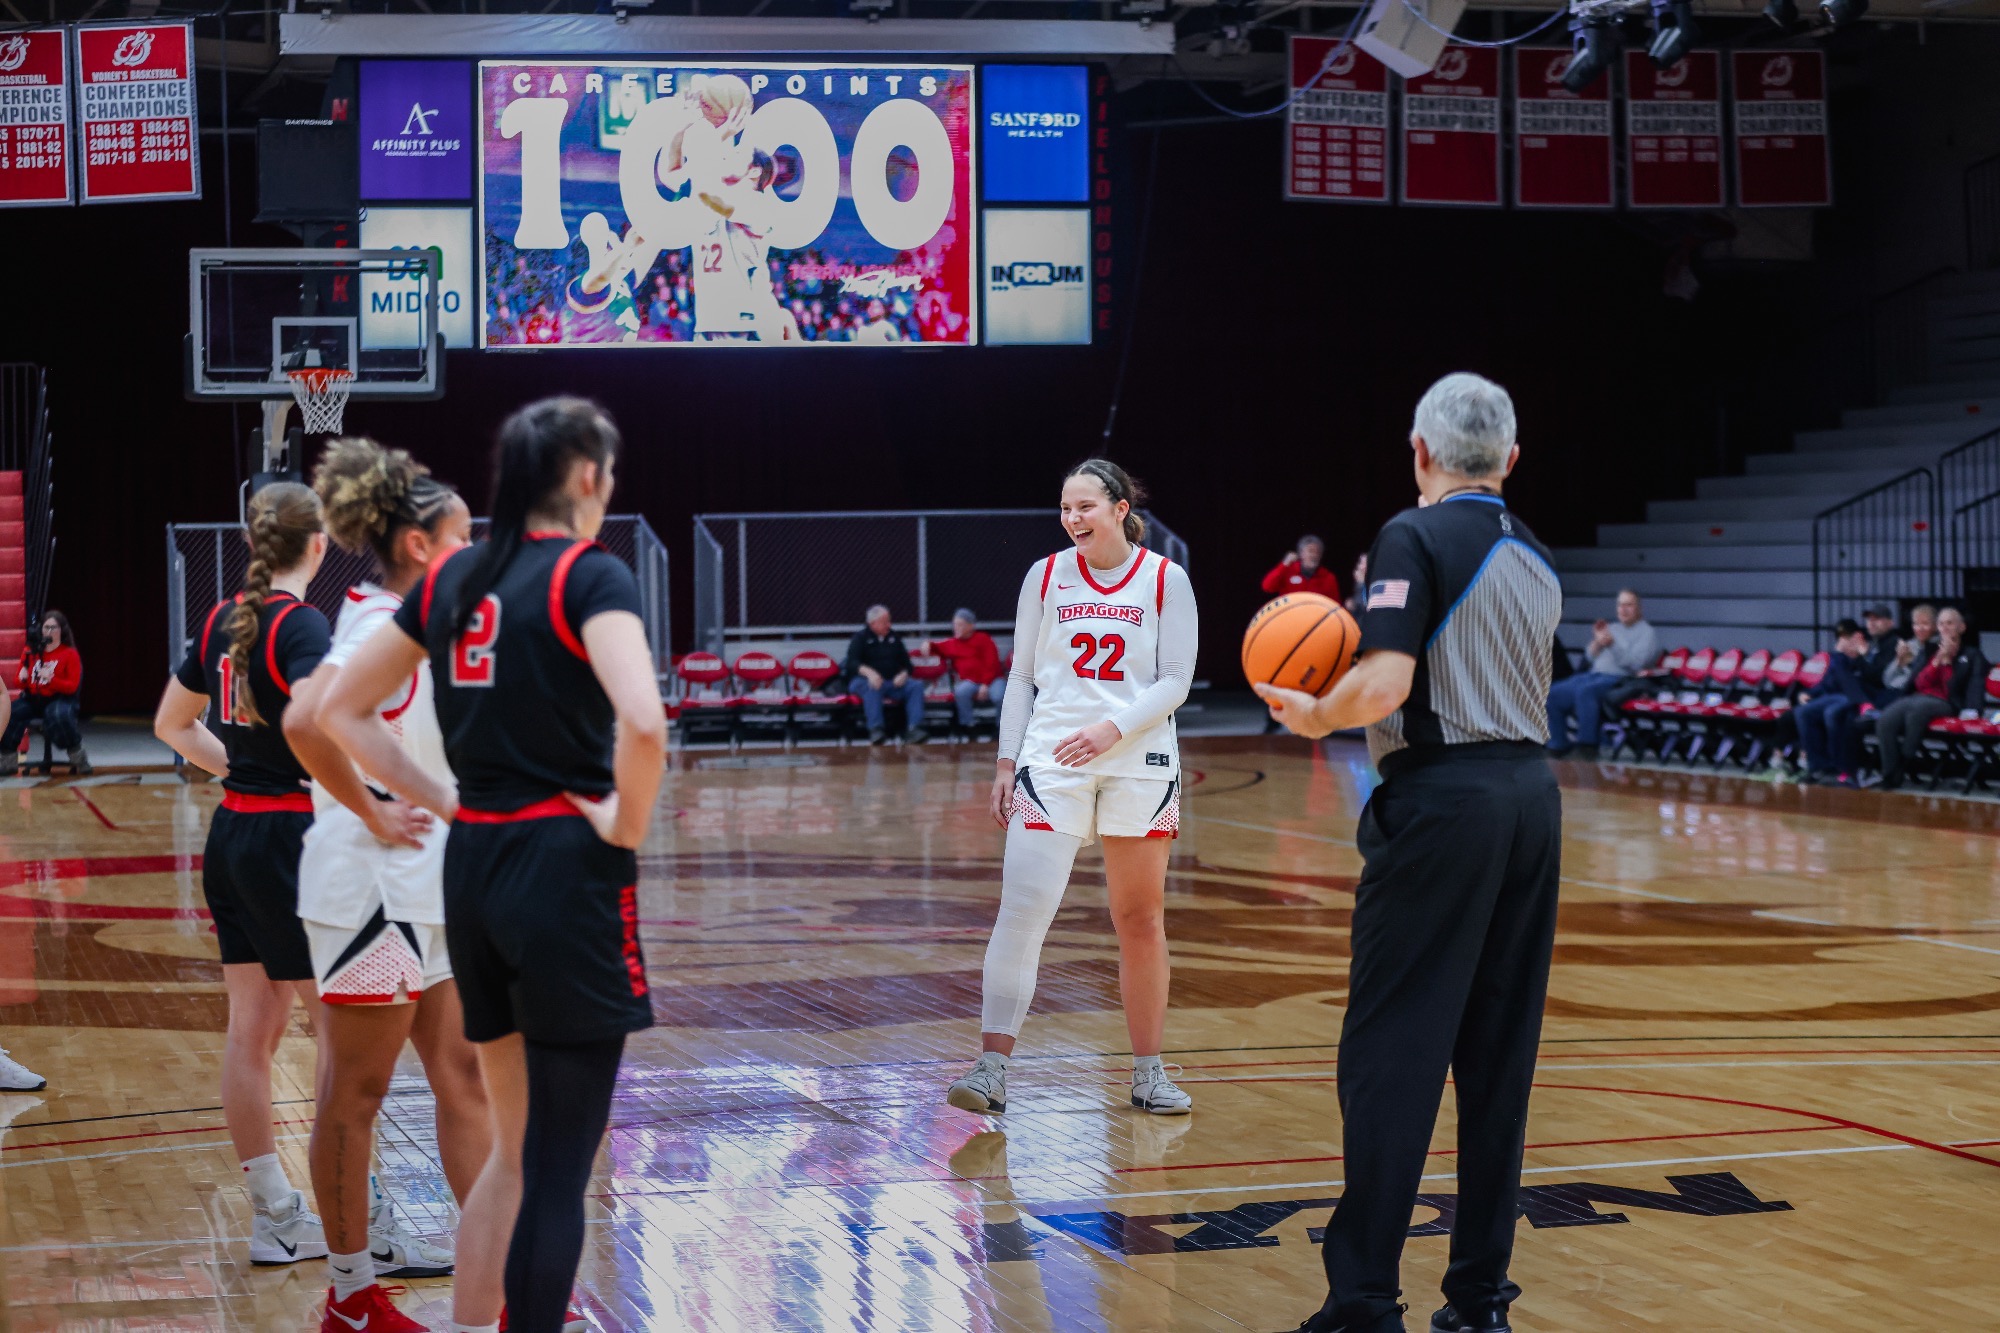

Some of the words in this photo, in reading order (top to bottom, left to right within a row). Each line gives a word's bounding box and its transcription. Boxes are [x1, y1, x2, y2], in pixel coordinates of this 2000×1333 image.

[92, 71, 128, 82] WOMEN'S
[130, 68, 178, 80] BASKETBALL
[86, 82, 186, 100] CONFERENCE
[752, 74, 937, 96] POINTS
[0, 88, 61, 105] ERENCE
[86, 99, 187, 119] CHAMPIONS
[990, 112, 1080, 127] SANFORD
[16, 127, 59, 140] 1970-71
[90, 122, 134, 137] 1981-82
[141, 120, 186, 134] 1984-85
[1008, 130, 1064, 138] HEALTH
[16, 141, 61, 154] 1981-82
[90, 136, 135, 151] 2004-05
[372, 139, 426, 151] AFFINITY
[430, 139, 460, 151] PLUS
[16, 155, 61, 168] 2016-17
[992, 265, 1083, 283] INFORUM
[1058, 603, 1144, 627] DRAGONS
[449, 593, 502, 688] 2
[1071, 633, 1125, 681] 22
